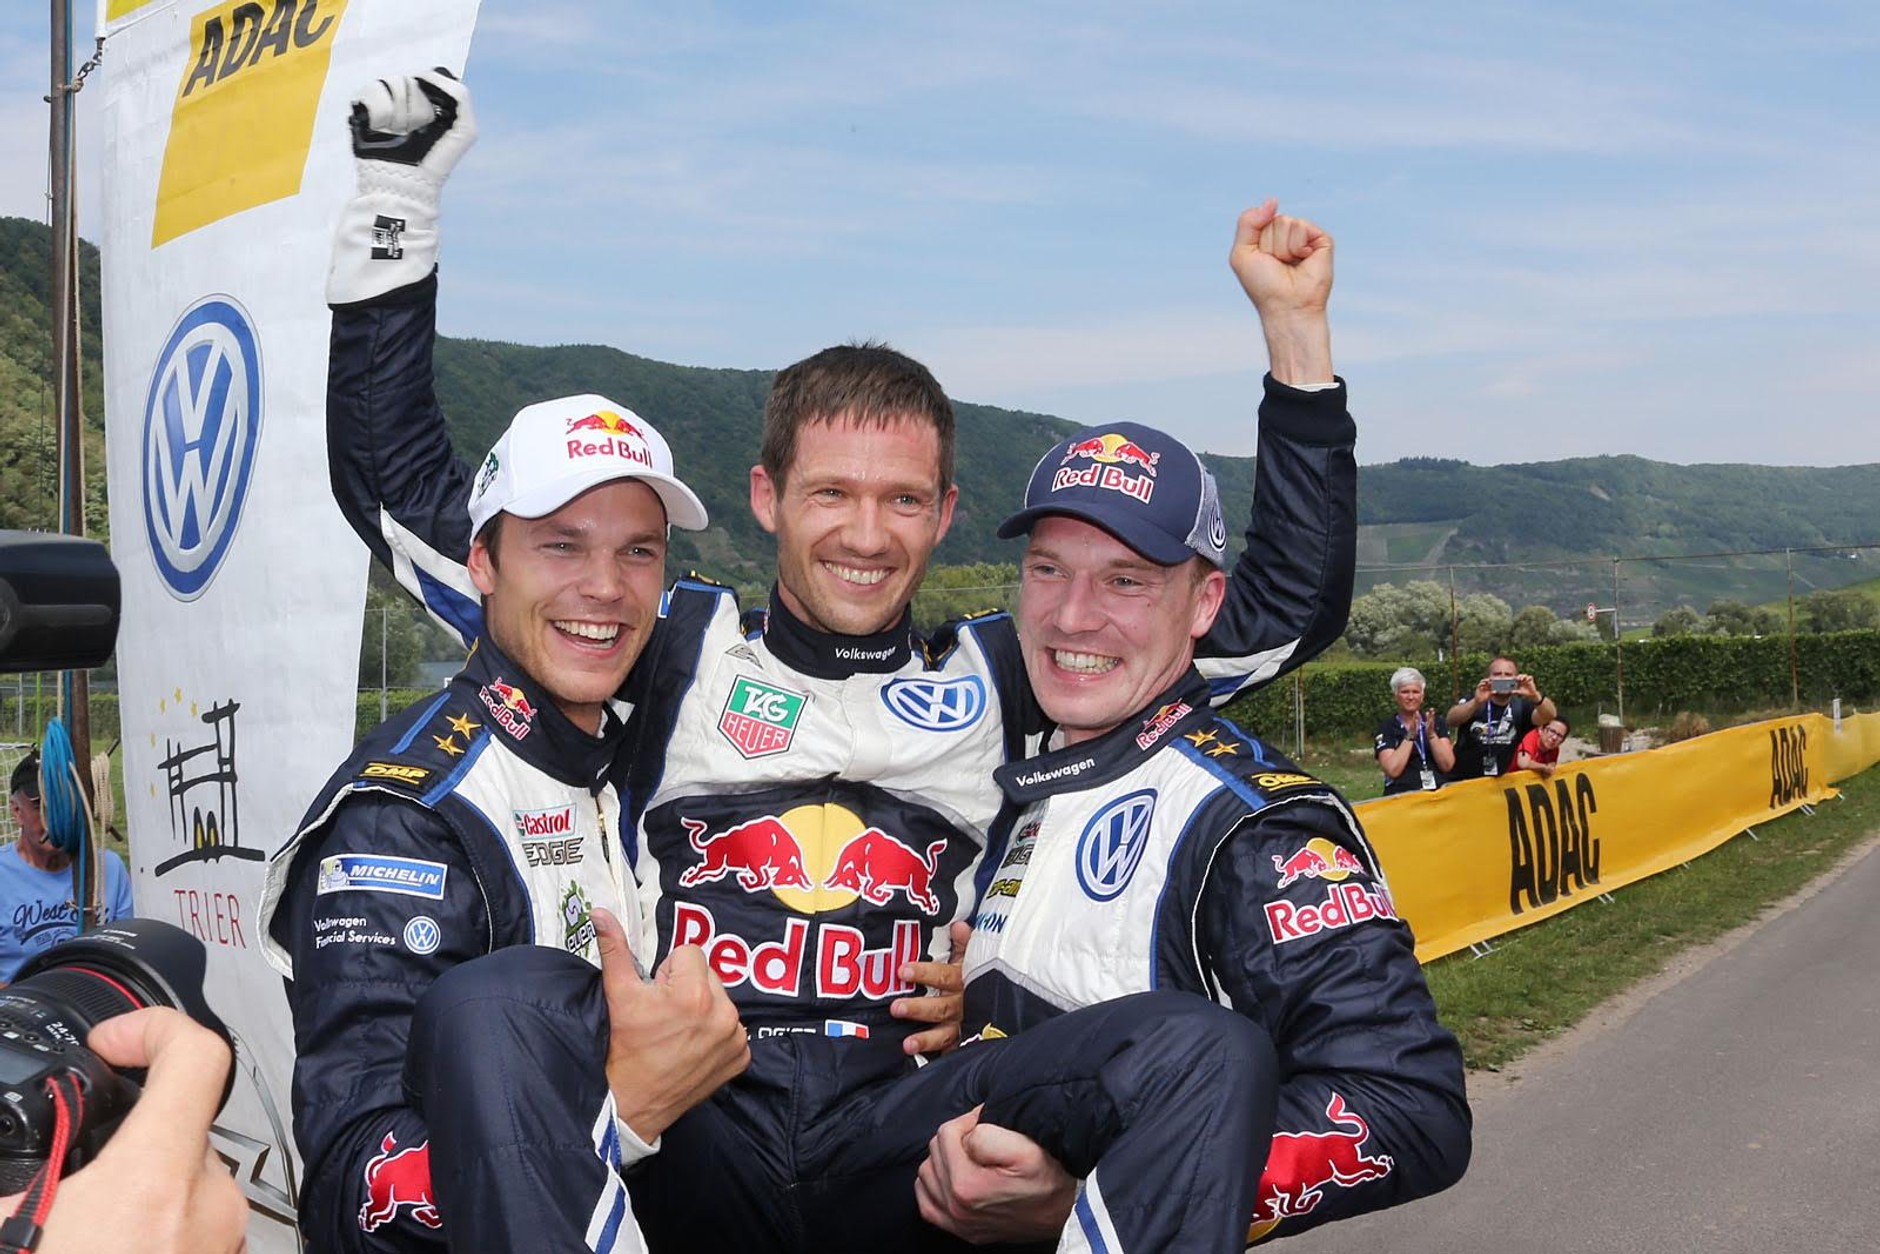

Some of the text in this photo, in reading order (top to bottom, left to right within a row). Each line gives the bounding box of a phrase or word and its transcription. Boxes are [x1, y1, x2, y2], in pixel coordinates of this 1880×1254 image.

[182, 0, 335, 98] ADAC
[567, 437, 653, 468] Red Bull
[1053, 464, 1154, 503] Red Bull
[480, 687, 530, 739] Red Bull
[744, 686, 789, 722] TAG
[725, 714, 786, 751] HEUER
[1137, 704, 1192, 749] Red Bull
[364, 766, 425, 778] OMP
[1016, 757, 1095, 787] Volkswagen
[1770, 724, 1808, 809] ADAC
[524, 809, 571, 835] Castrol
[522, 837, 584, 867] EDGE
[1504, 773, 1600, 915] ADAC
[350, 865, 440, 885] MICHELIN
[175, 890, 247, 949] TRIER
[314, 917, 366, 931] Volwagen
[1265, 885, 1348, 943] Red
[316, 930, 396, 949] Fcial Services
[670, 902, 920, 999] Red Bull
